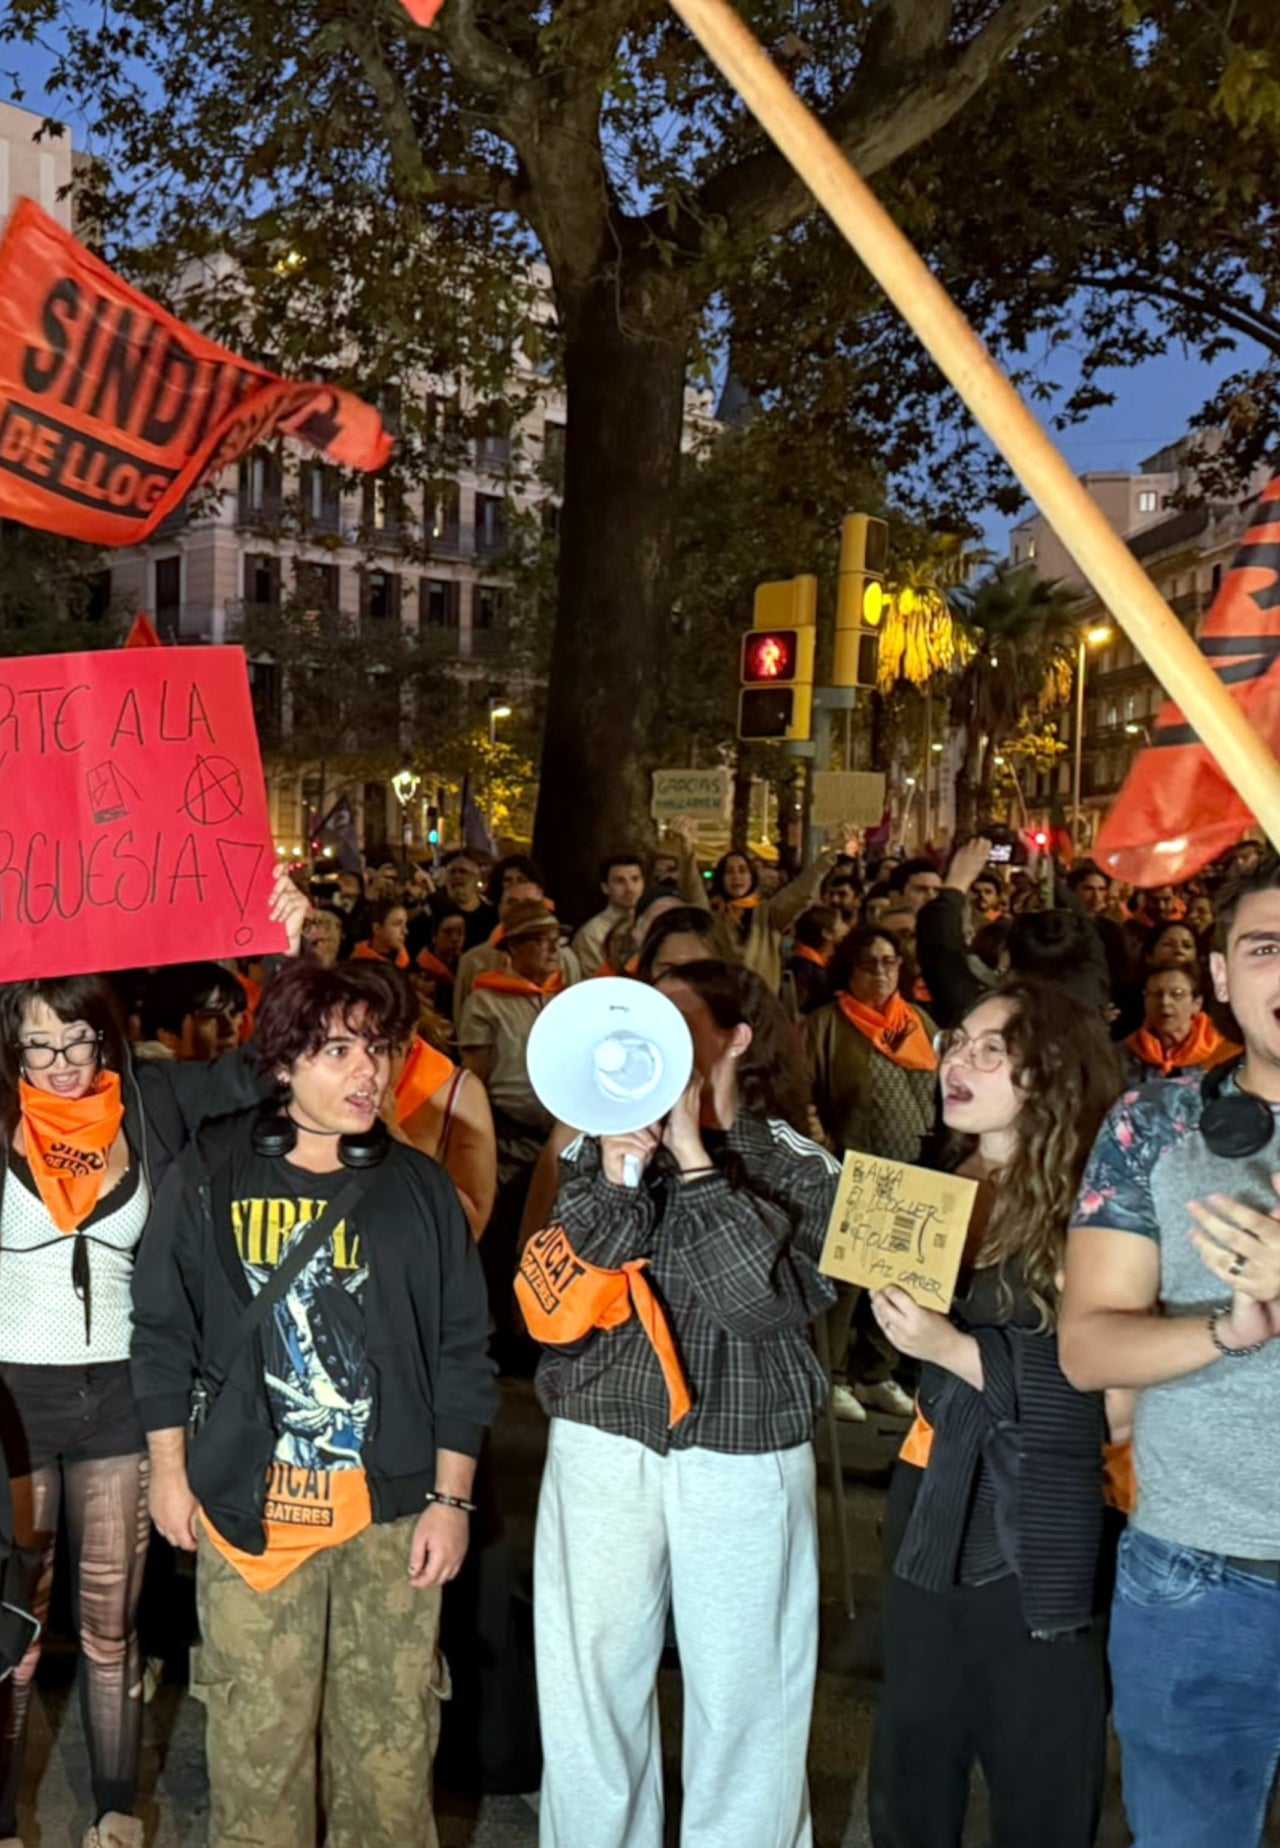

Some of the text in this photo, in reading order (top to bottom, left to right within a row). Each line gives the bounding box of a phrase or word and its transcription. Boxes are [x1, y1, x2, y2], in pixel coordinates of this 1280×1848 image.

[110, 688, 144, 748] A
[159, 680, 217, 745] LA
[264, 1501, 331, 1526] GATERES
